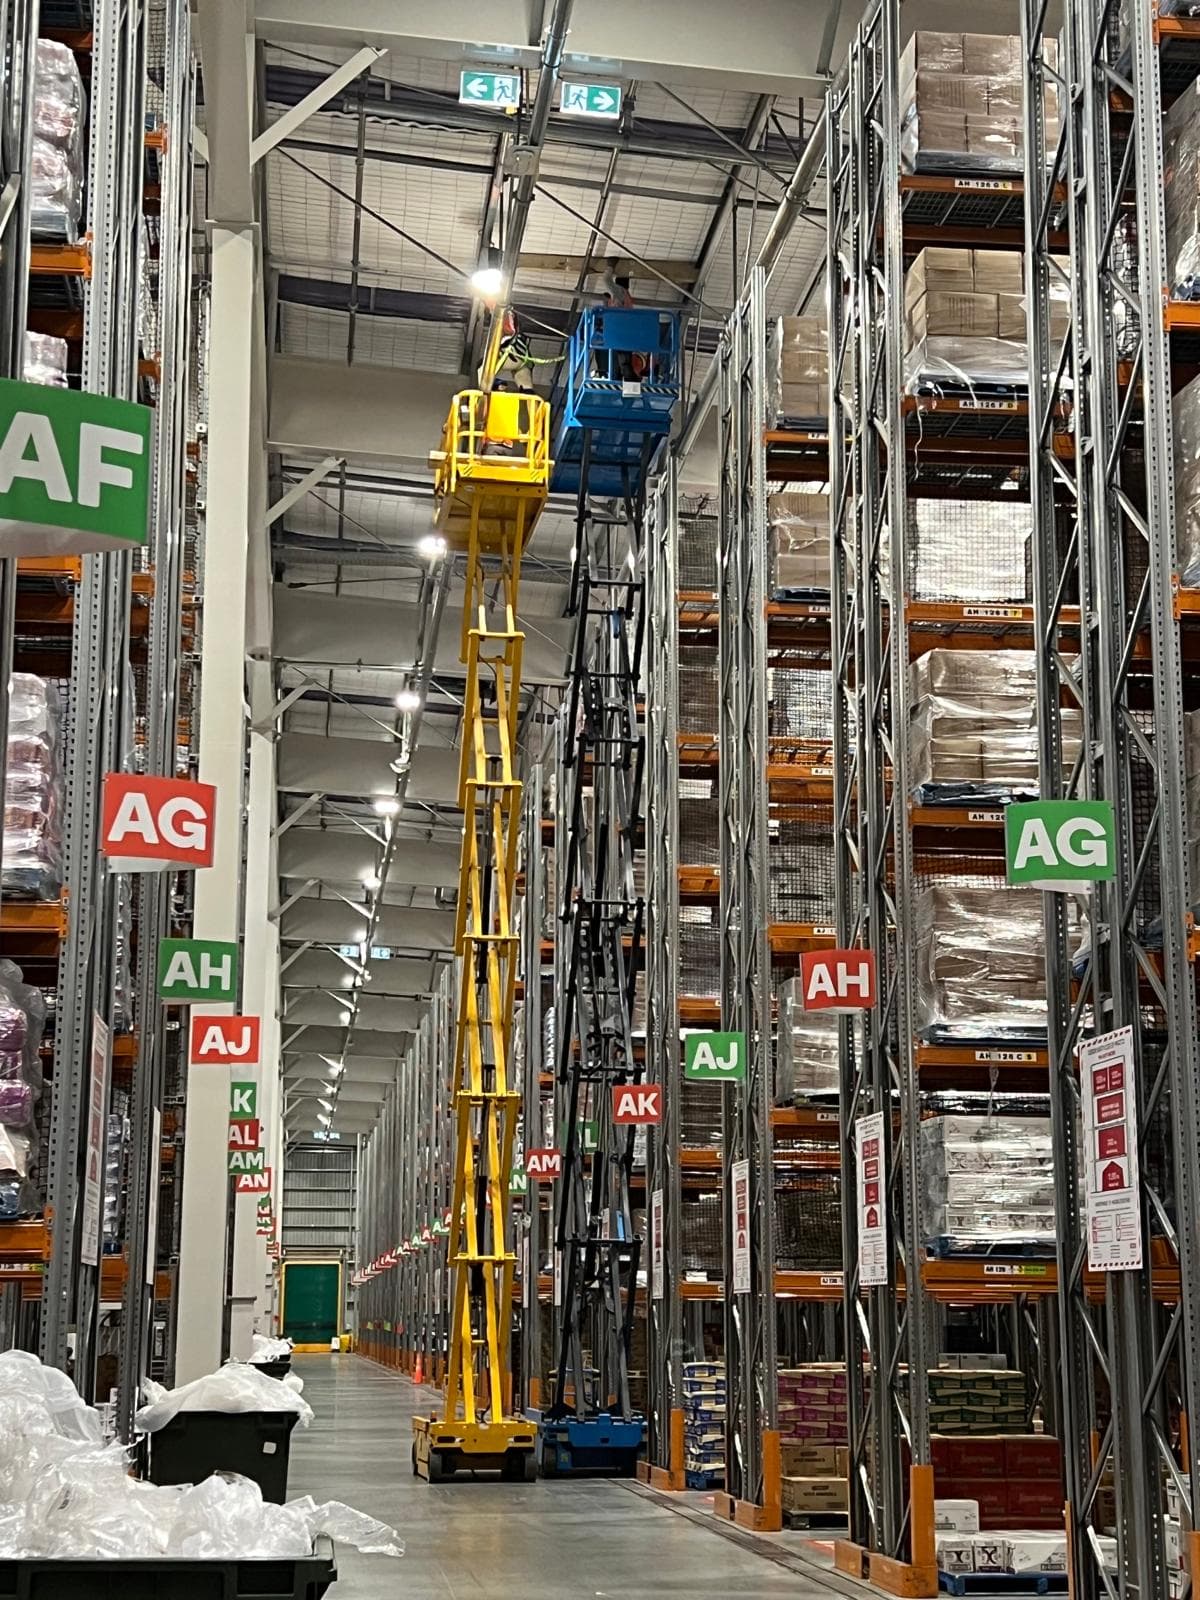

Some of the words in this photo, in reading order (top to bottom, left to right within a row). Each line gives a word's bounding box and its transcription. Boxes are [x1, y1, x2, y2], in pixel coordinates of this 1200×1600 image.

[0, 411, 143, 508] AF
[107, 792, 207, 851] AG
[1014, 817, 1108, 869] AG
[162, 951, 232, 991] AH
[806, 962, 870, 1000] AH
[199, 1025, 252, 1056] AJ
[691, 1041, 739, 1071] AJ
[230, 1088, 254, 1113] K
[617, 1092, 659, 1117] AK
[228, 1125, 256, 1146] AL
[229, 1152, 264, 1170] AM
[526, 1155, 560, 1173] AM
[238, 1172, 269, 1188] AN
[508, 1174, 527, 1190] N
